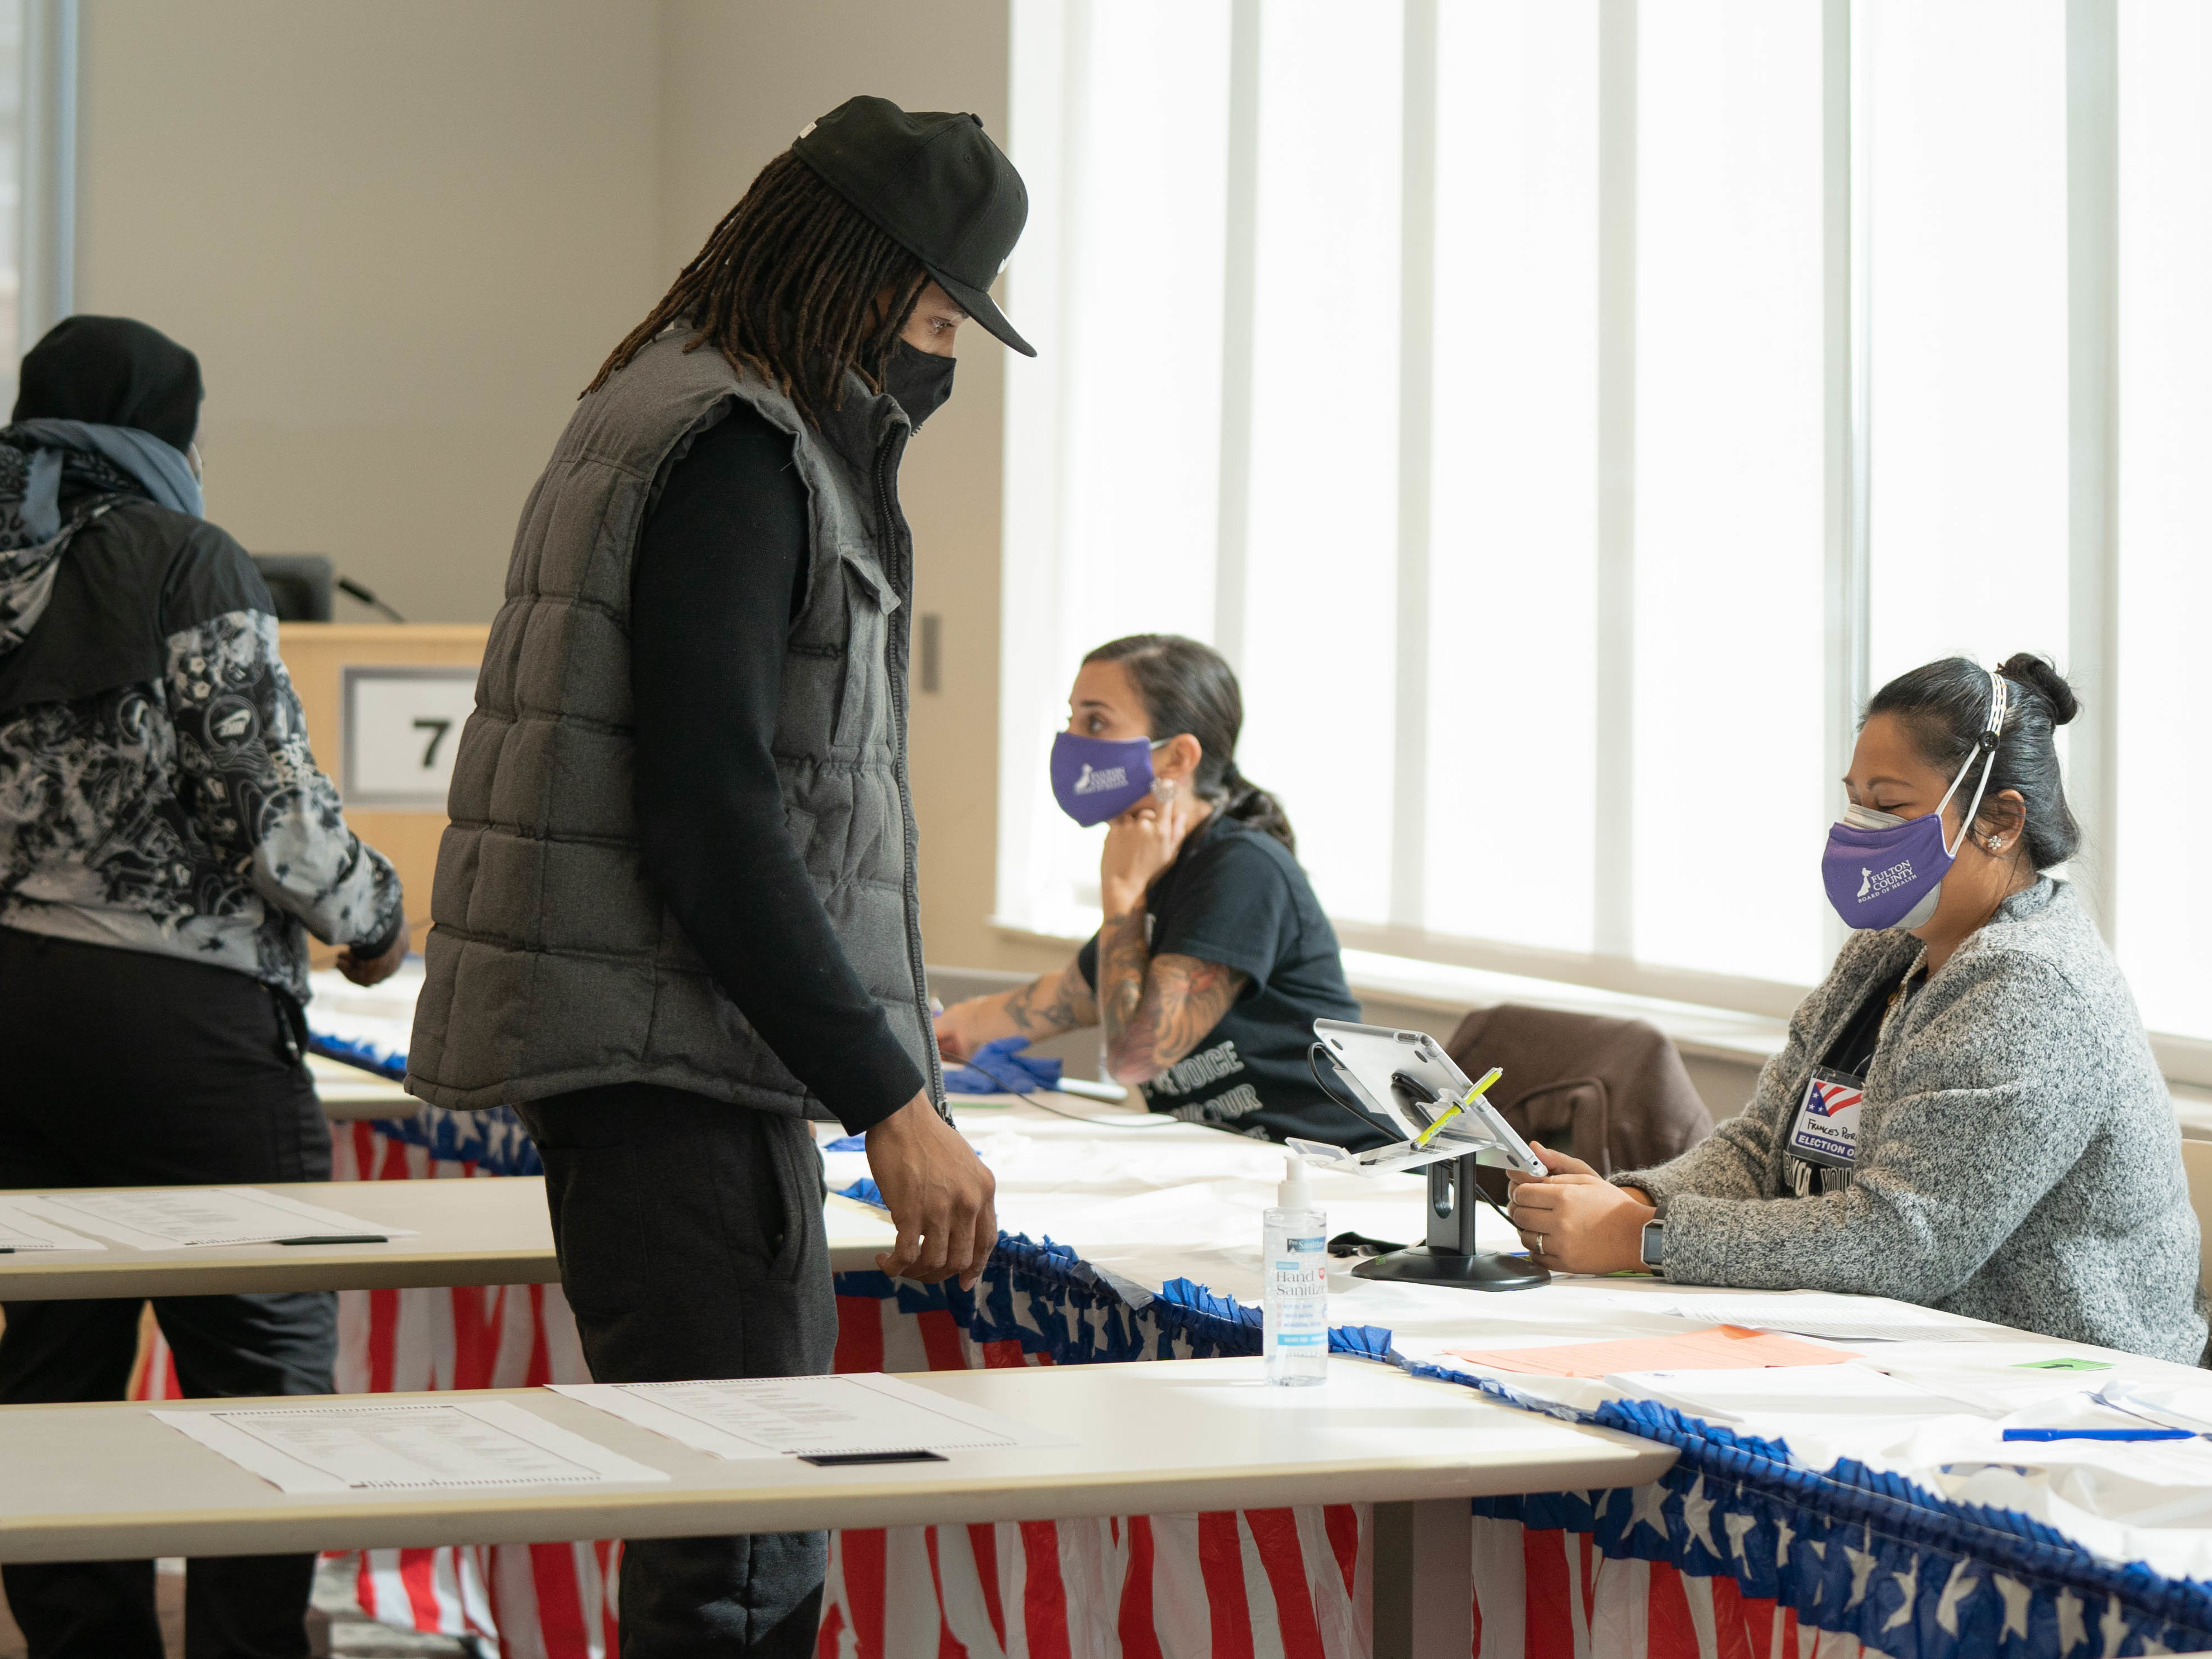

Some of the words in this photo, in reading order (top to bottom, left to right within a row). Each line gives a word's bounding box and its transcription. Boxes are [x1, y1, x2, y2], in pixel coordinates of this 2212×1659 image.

[414, 718, 451, 769] 7
[1871, 860, 1910, 883] FULTON
[1873, 867, 1913, 890] COUNTY
[1858, 892, 1880, 903] BOARD
[1891, 874, 1917, 889] HEALTH
[1172, 1040, 1245, 1094] VOICE
[1798, 1135, 1846, 1156] ELECTION
[1847, 1148, 1855, 1156] O
[1277, 1270, 1314, 1283] Hand
